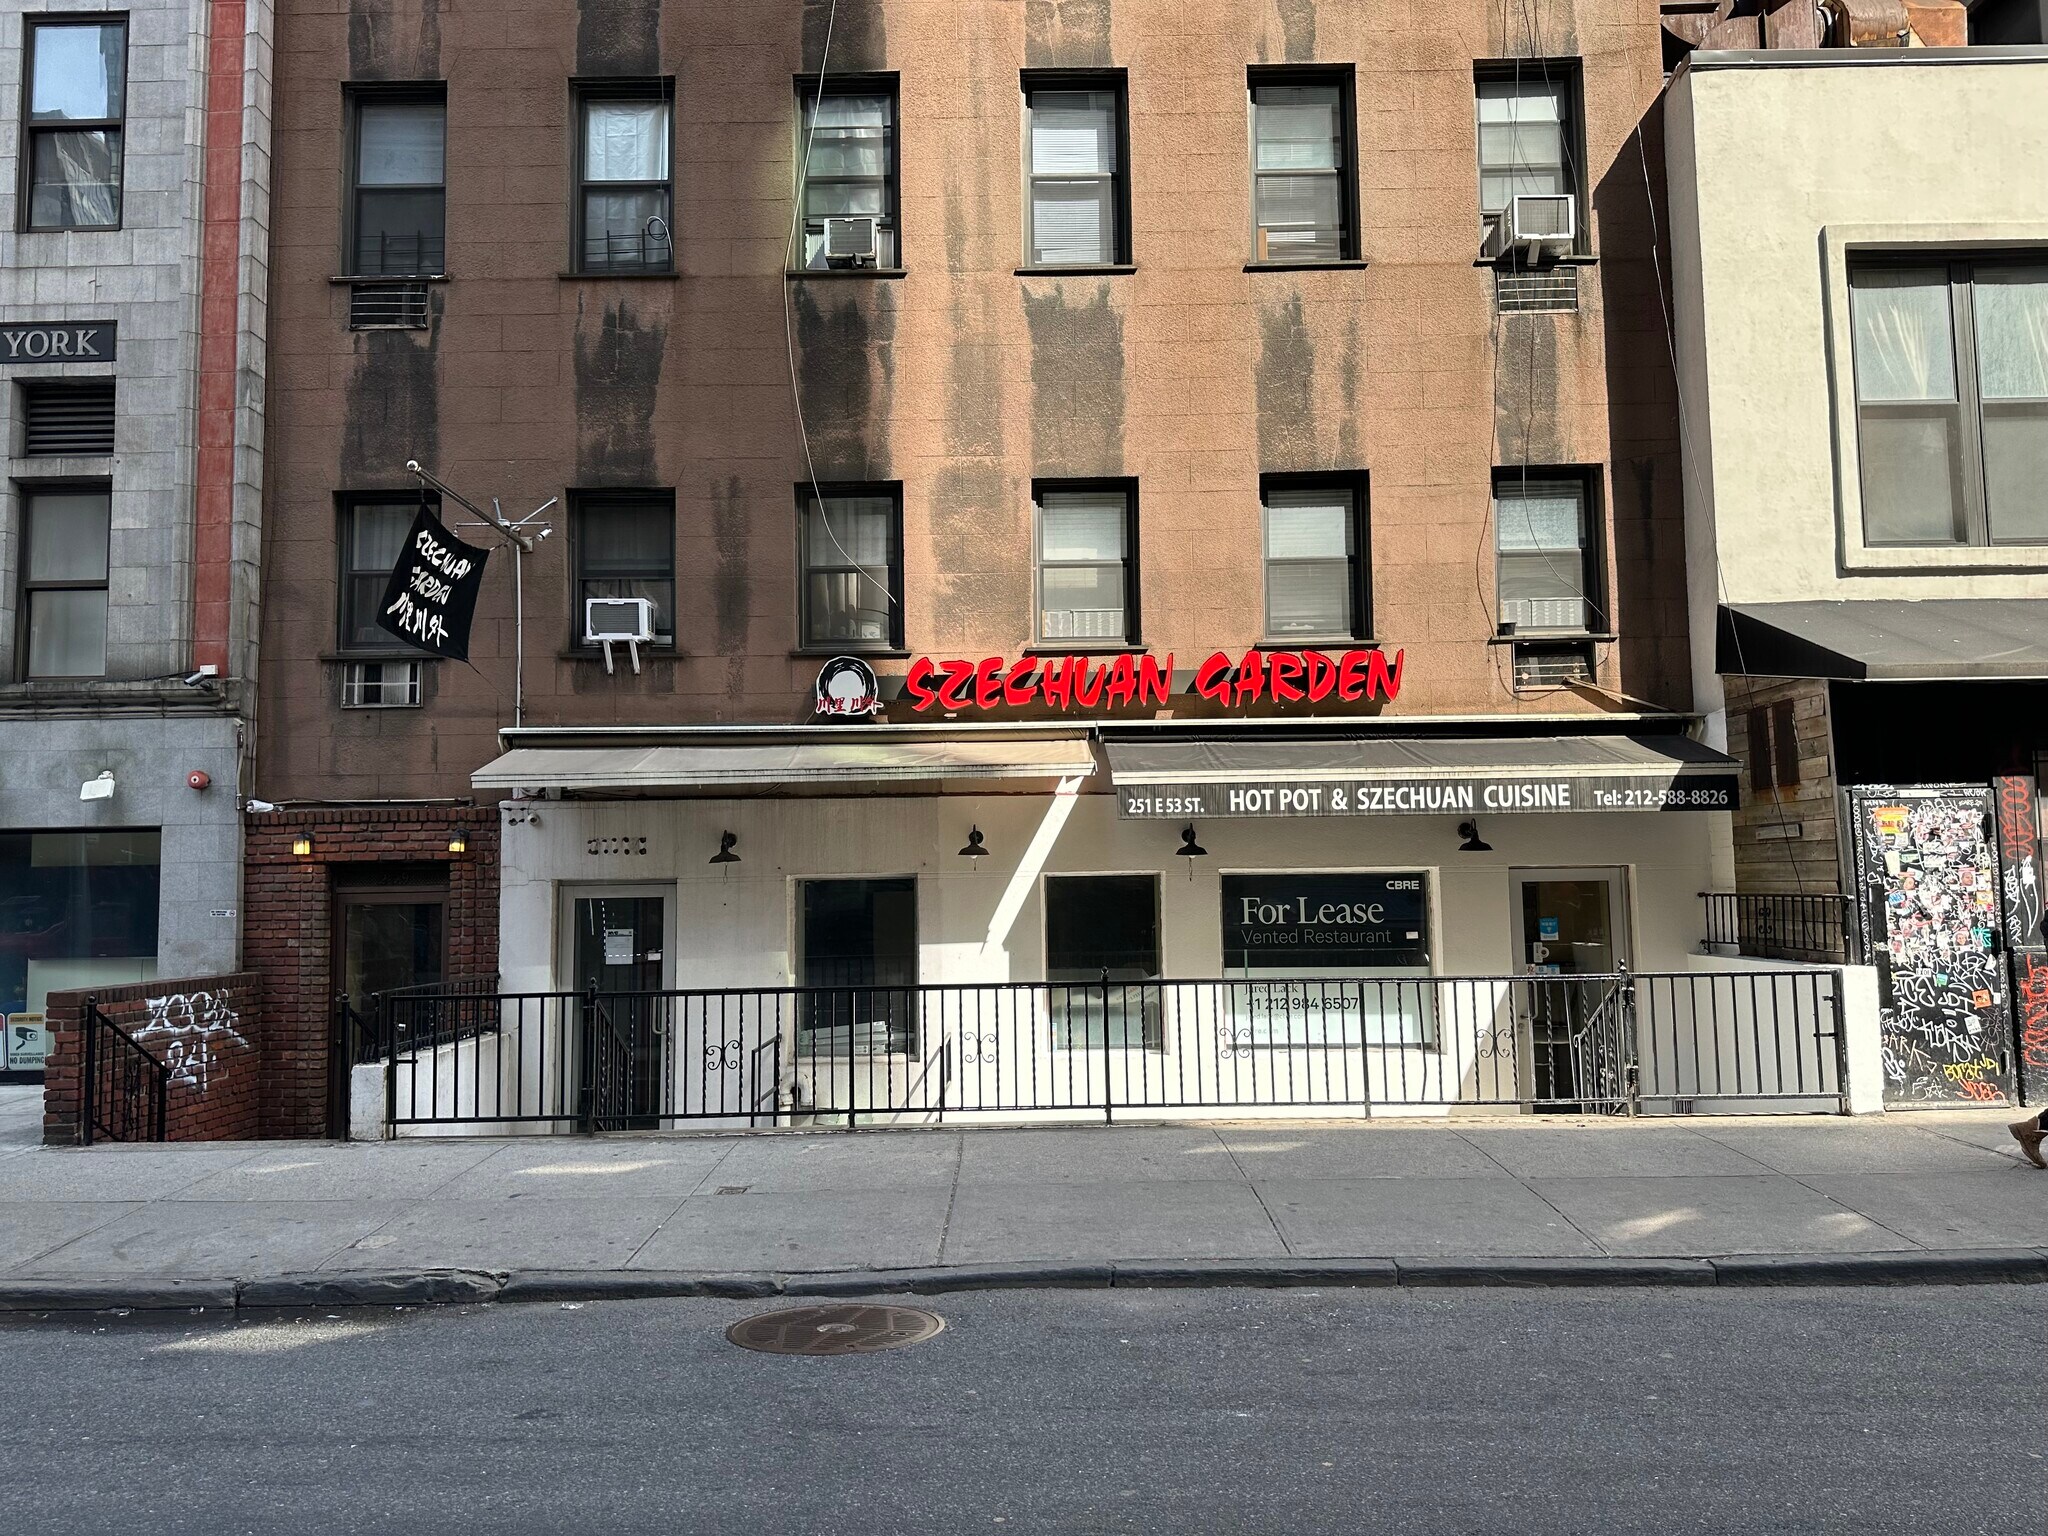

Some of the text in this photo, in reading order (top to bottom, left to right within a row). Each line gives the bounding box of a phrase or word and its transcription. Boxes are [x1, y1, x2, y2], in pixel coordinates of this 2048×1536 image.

[3, 329, 100, 357] YORK
[906, 648, 1404, 712] SZECHUAN GARDEN
[1128, 797, 1205, 813] 251 E 53 ST.
[1230, 783, 1571, 812] HOT POT & SZECHUAN CUISINE
[1594, 789, 1729, 806] Tel: 212-588-8826
[1386, 880, 1420, 890] CBRE
[1240, 896, 1385, 925] For Lease
[1241, 929, 1391, 944] Vented Restaurant
[1292, 997, 1319, 1010] 984
[1324, 998, 1359, 1010] 6507
[20, 1056, 45, 1064] DUMPING
